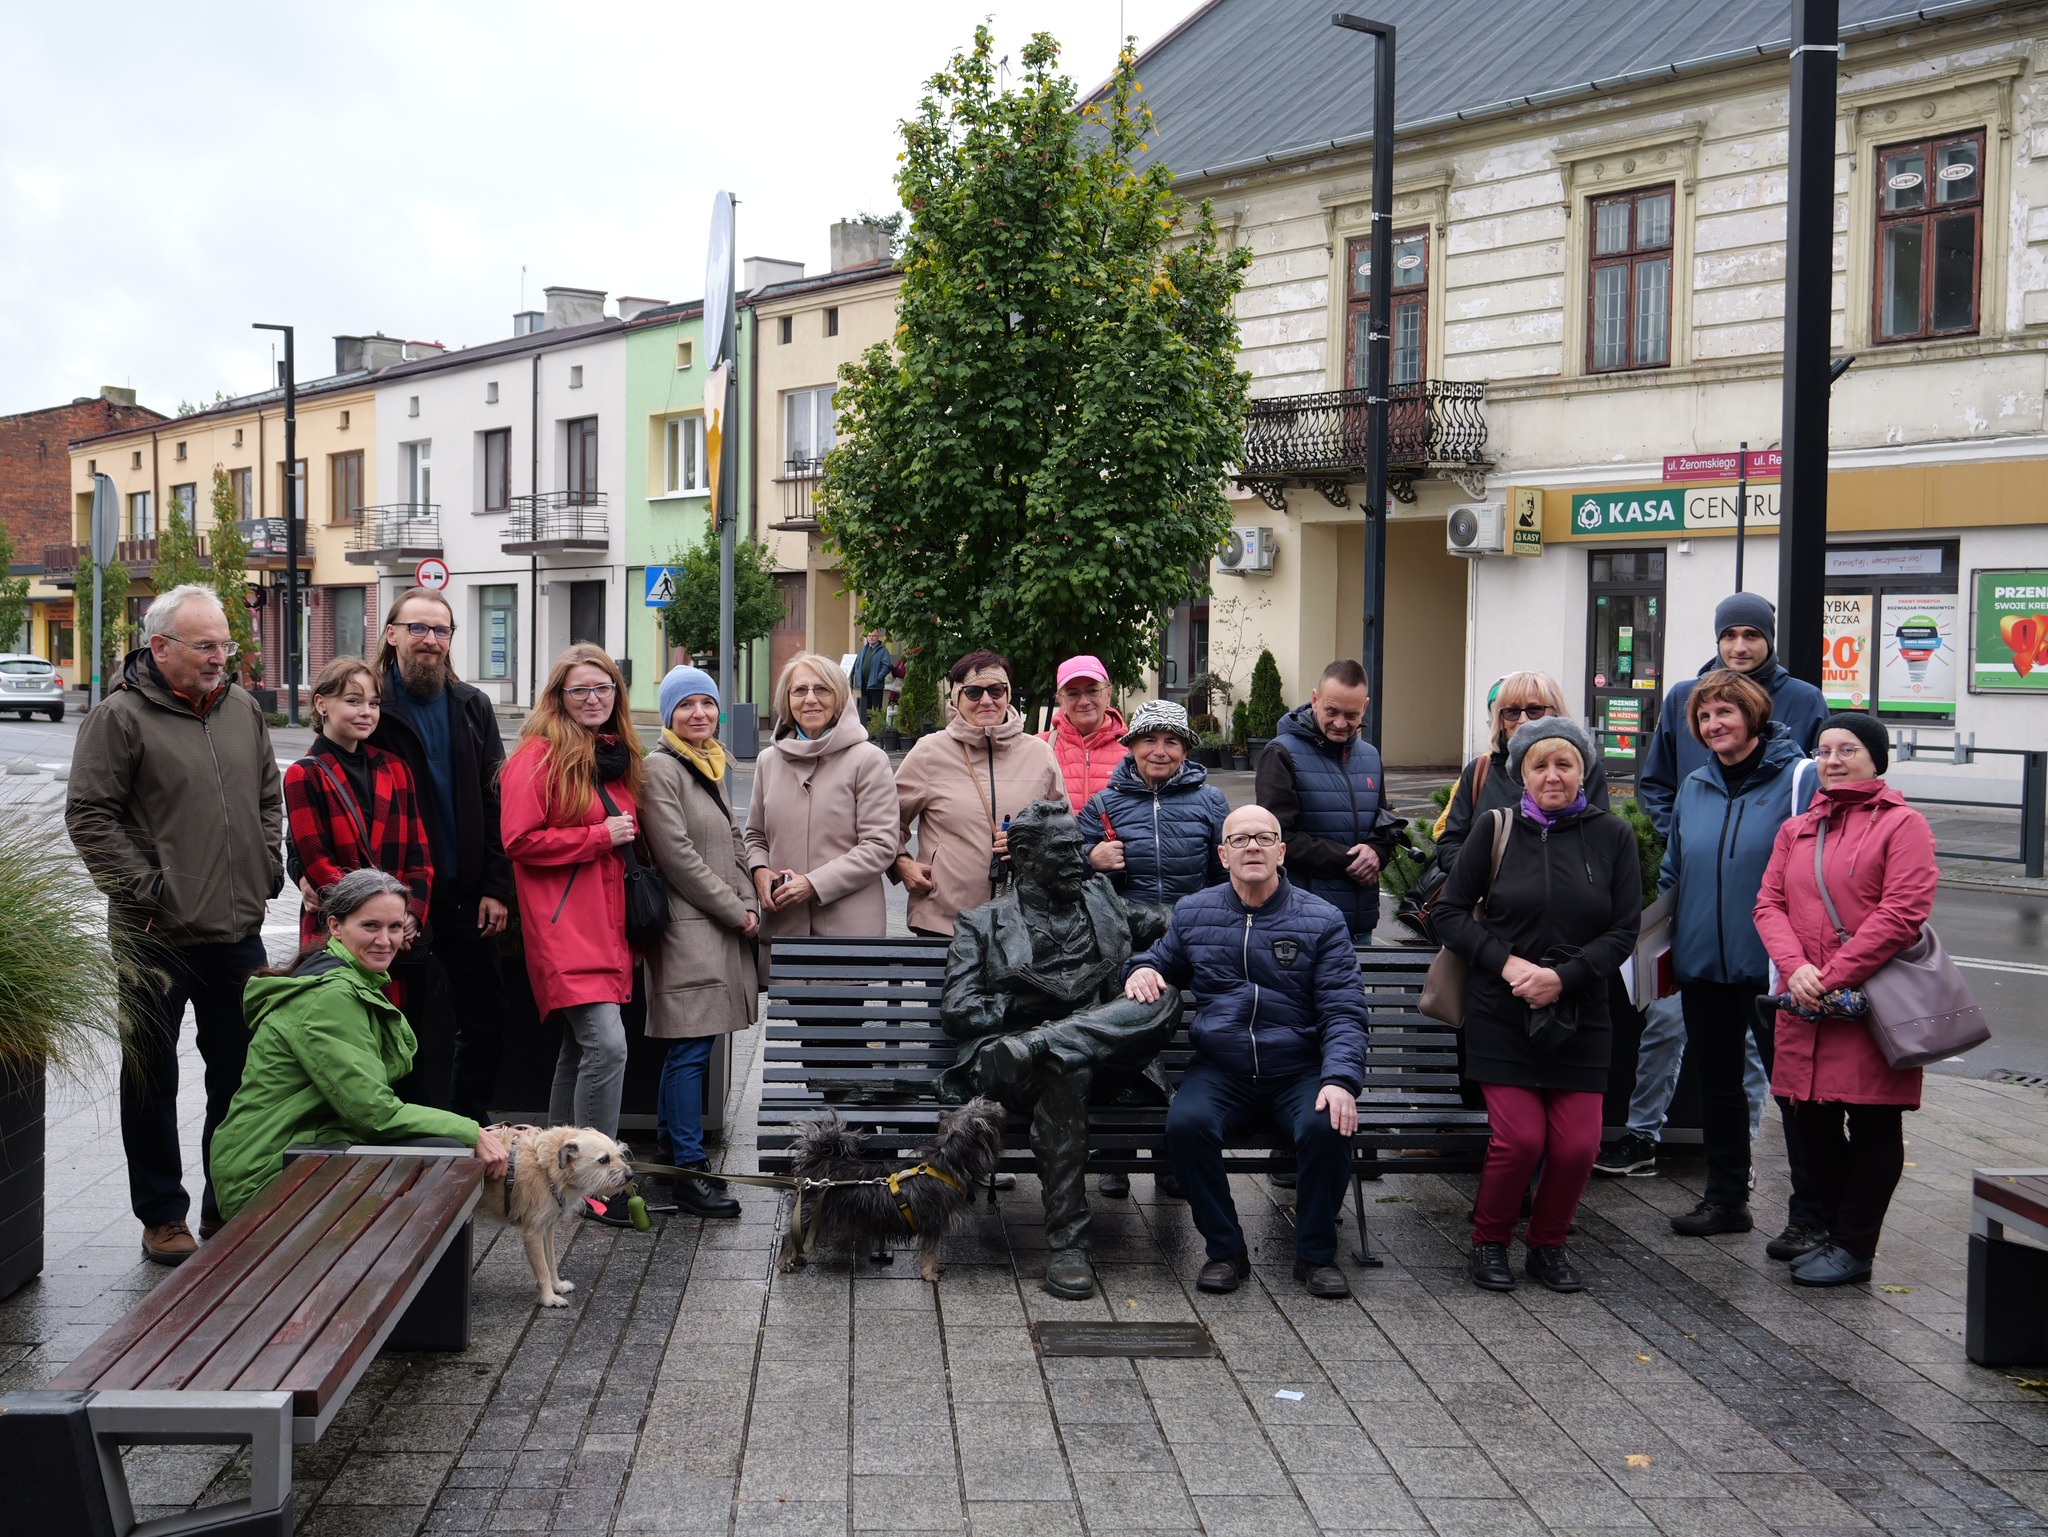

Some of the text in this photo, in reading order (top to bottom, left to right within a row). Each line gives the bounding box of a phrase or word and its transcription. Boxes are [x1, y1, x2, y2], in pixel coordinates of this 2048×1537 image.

[1667, 458, 1736, 471] ul. Żeromskiego
[1754, 454, 1782, 466] ul. Re
[1609, 493, 1781, 523] KASA CENTRU
[1522, 533, 1540, 542] KASY
[1515, 544, 1539, 552] STEFCZYKA
[1832, 553, 1923, 568] Pamiętaj, ubezpiecz się!
[1823, 600, 1861, 613] YBKA
[1994, 602, 2048, 610] SWOJE KRE
[1823, 613, 1860, 625] ŻYCZKA
[1822, 670, 1859, 681] INUT
[1609, 699, 1639, 707] PRZENIEŚ
